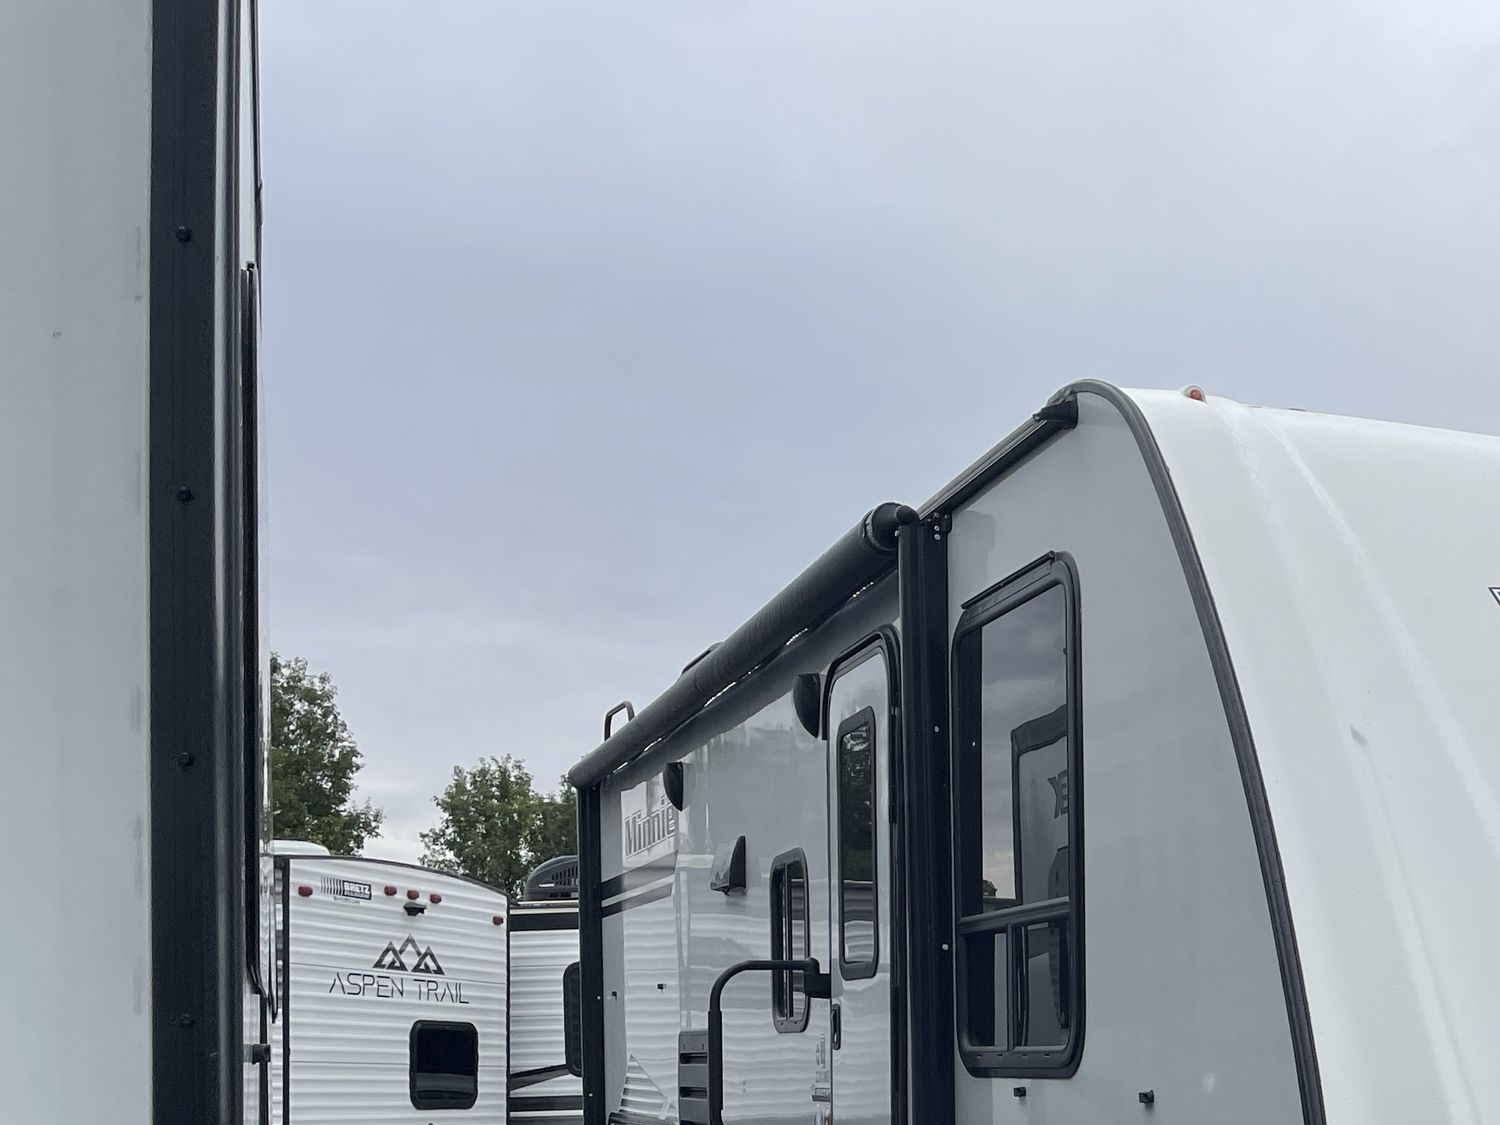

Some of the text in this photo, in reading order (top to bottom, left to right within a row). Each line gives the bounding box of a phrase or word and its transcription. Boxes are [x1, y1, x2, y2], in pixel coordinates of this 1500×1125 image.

[624, 794, 676, 859] Minnie
[343, 881, 370, 895] BRETZ
[329, 972, 470, 1004] ASPEN TRAIL
